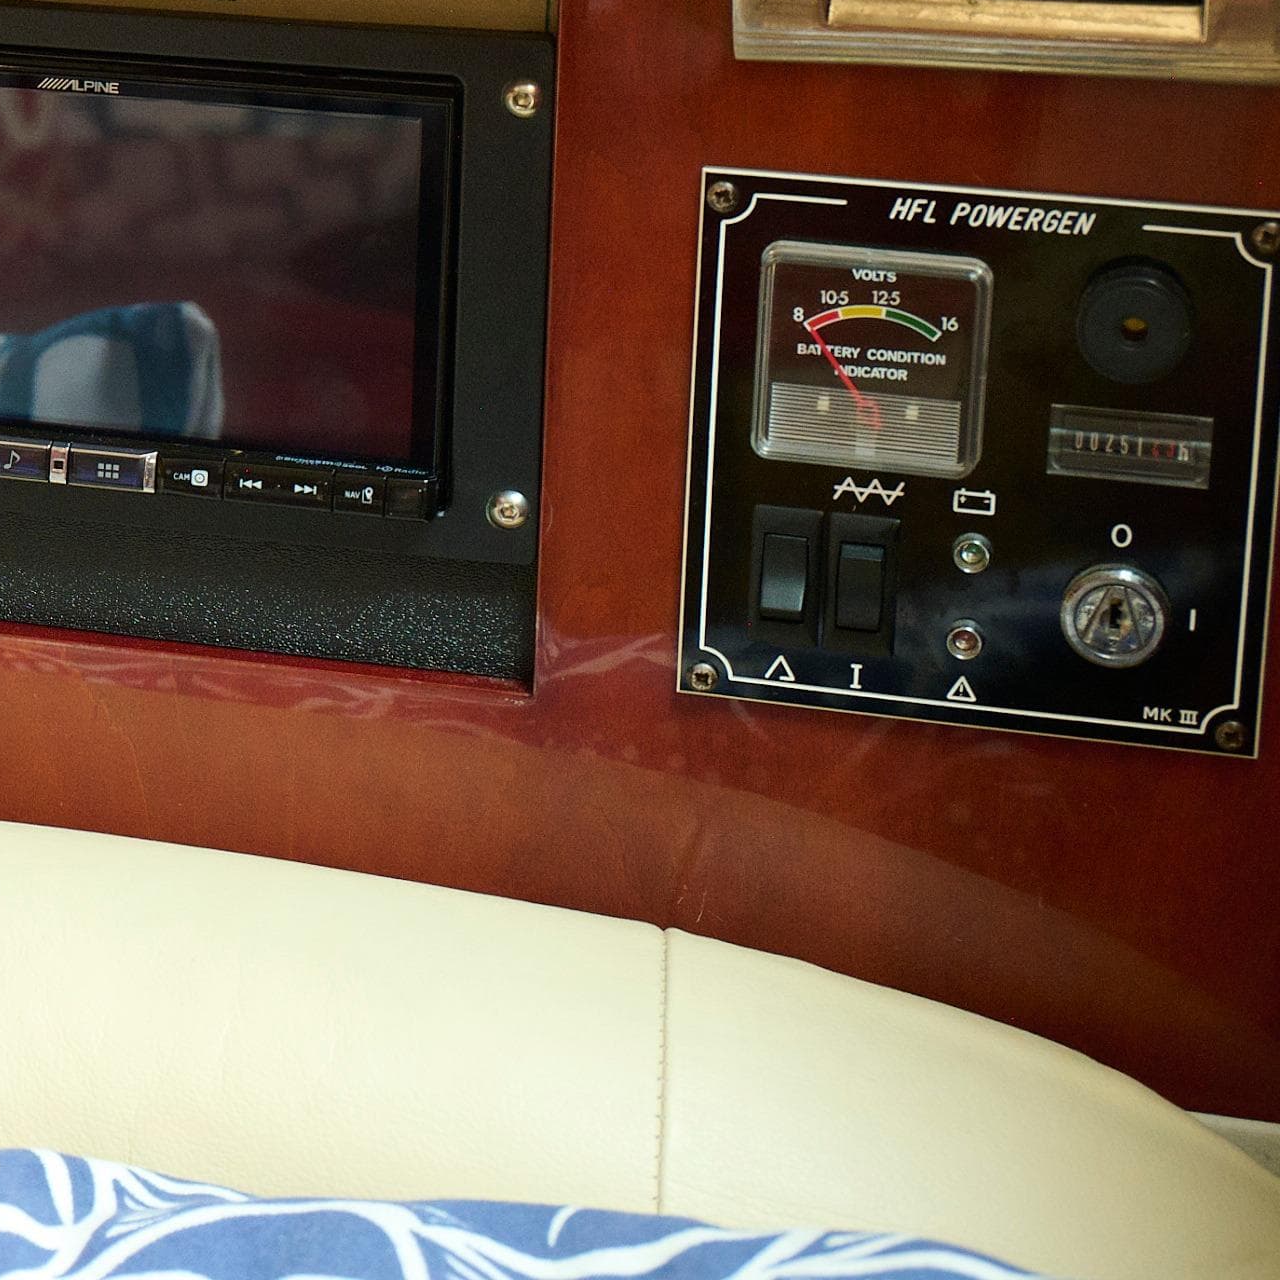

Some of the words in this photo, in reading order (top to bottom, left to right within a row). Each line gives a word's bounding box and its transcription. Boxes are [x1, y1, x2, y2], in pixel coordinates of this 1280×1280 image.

[52, 78, 120, 95] ALPINE
[890, 197, 938, 225] HFL
[949, 201, 1097, 237] POWERGEN
[851, 267, 897, 284] VOLTS
[792, 306, 805, 322] 8
[940, 316, 959, 332] 16
[866, 348, 947, 366] CONDITION
[172, 472, 191, 483] CAM
[344, 489, 361, 500] NAV
[1142, 705, 1172, 722] MK
[1178, 708, 1200, 725] III
